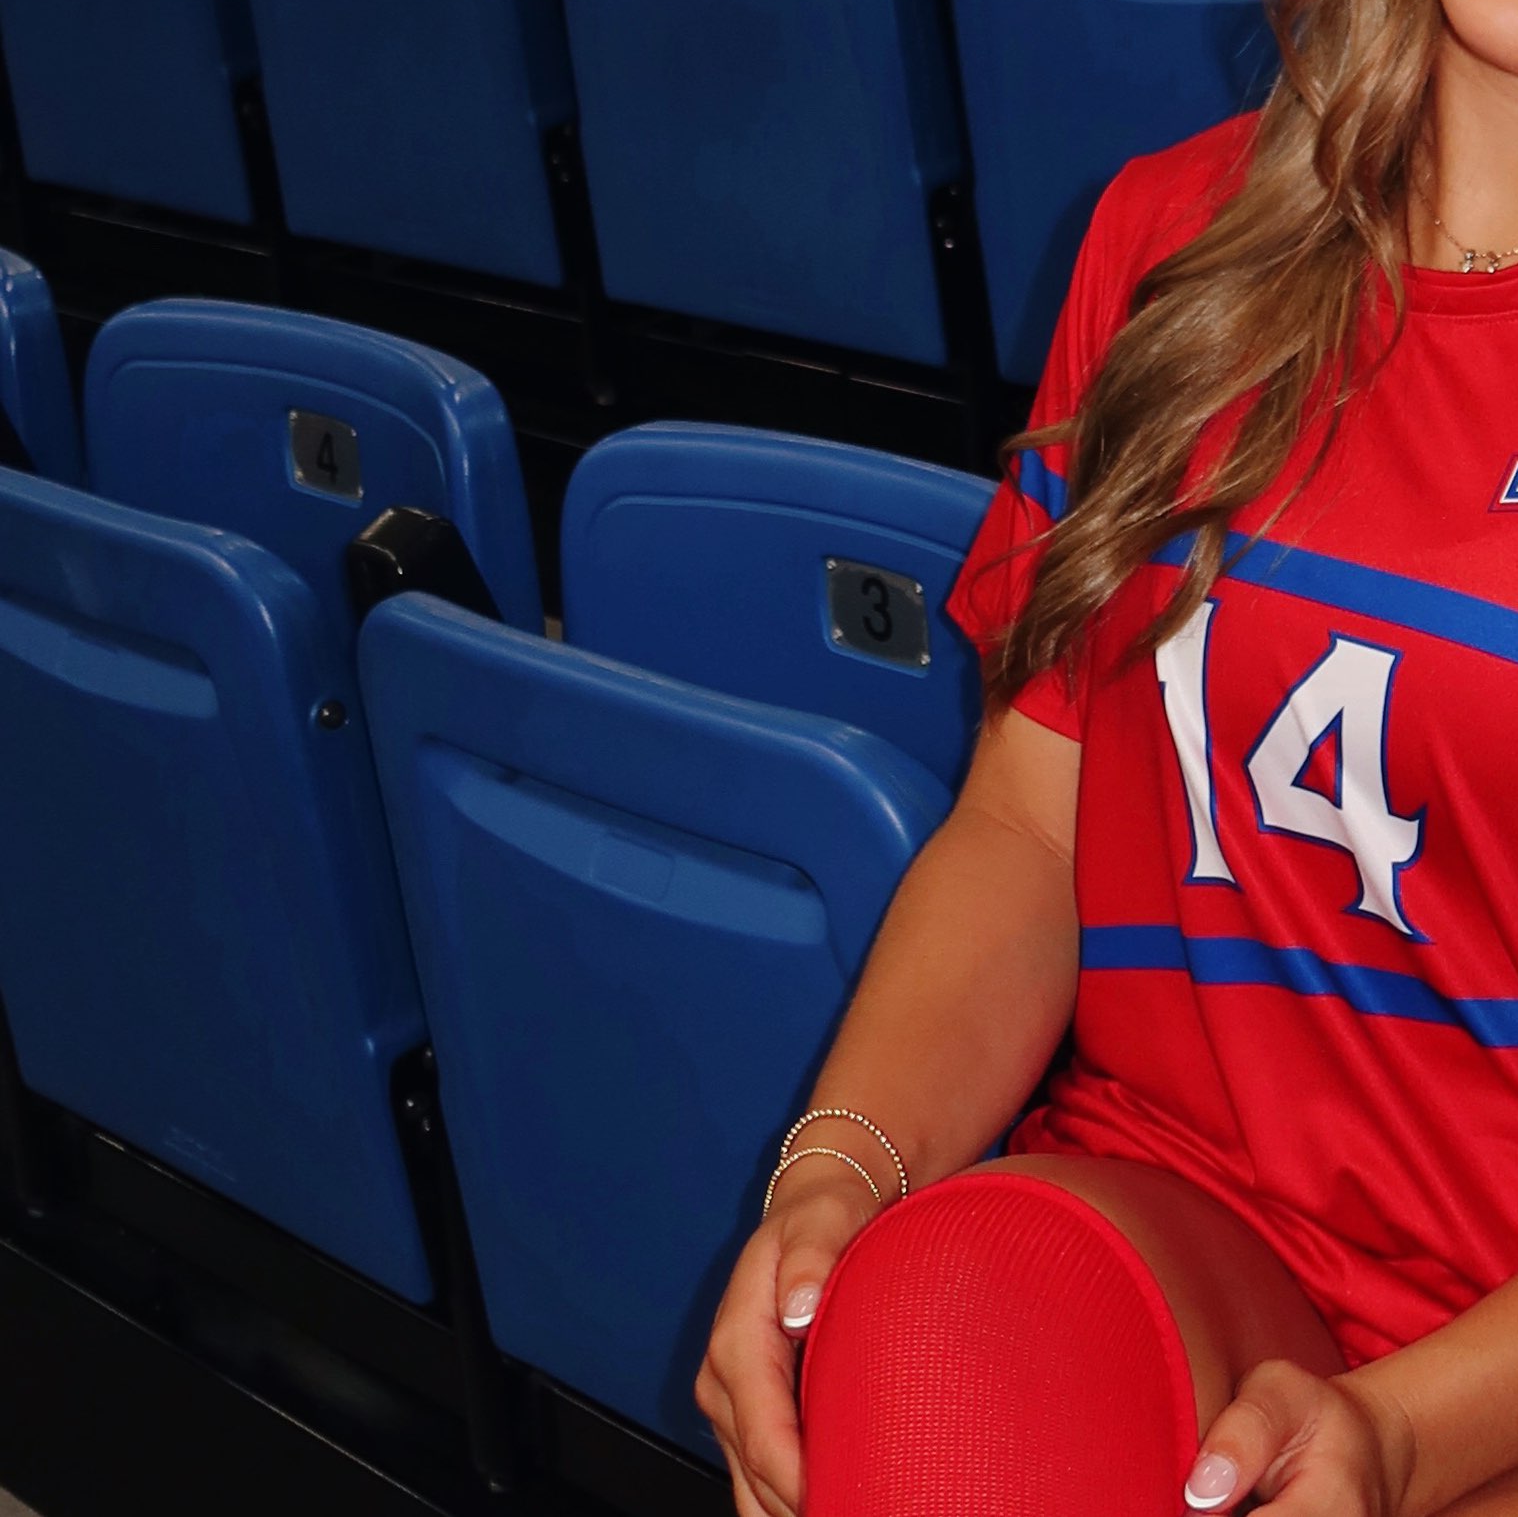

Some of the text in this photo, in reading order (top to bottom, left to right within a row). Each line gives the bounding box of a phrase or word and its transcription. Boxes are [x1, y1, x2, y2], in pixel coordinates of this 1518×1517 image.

[317, 431, 338, 485] 4
[861, 577, 893, 642] 3
[1155, 598, 1434, 942] 14
